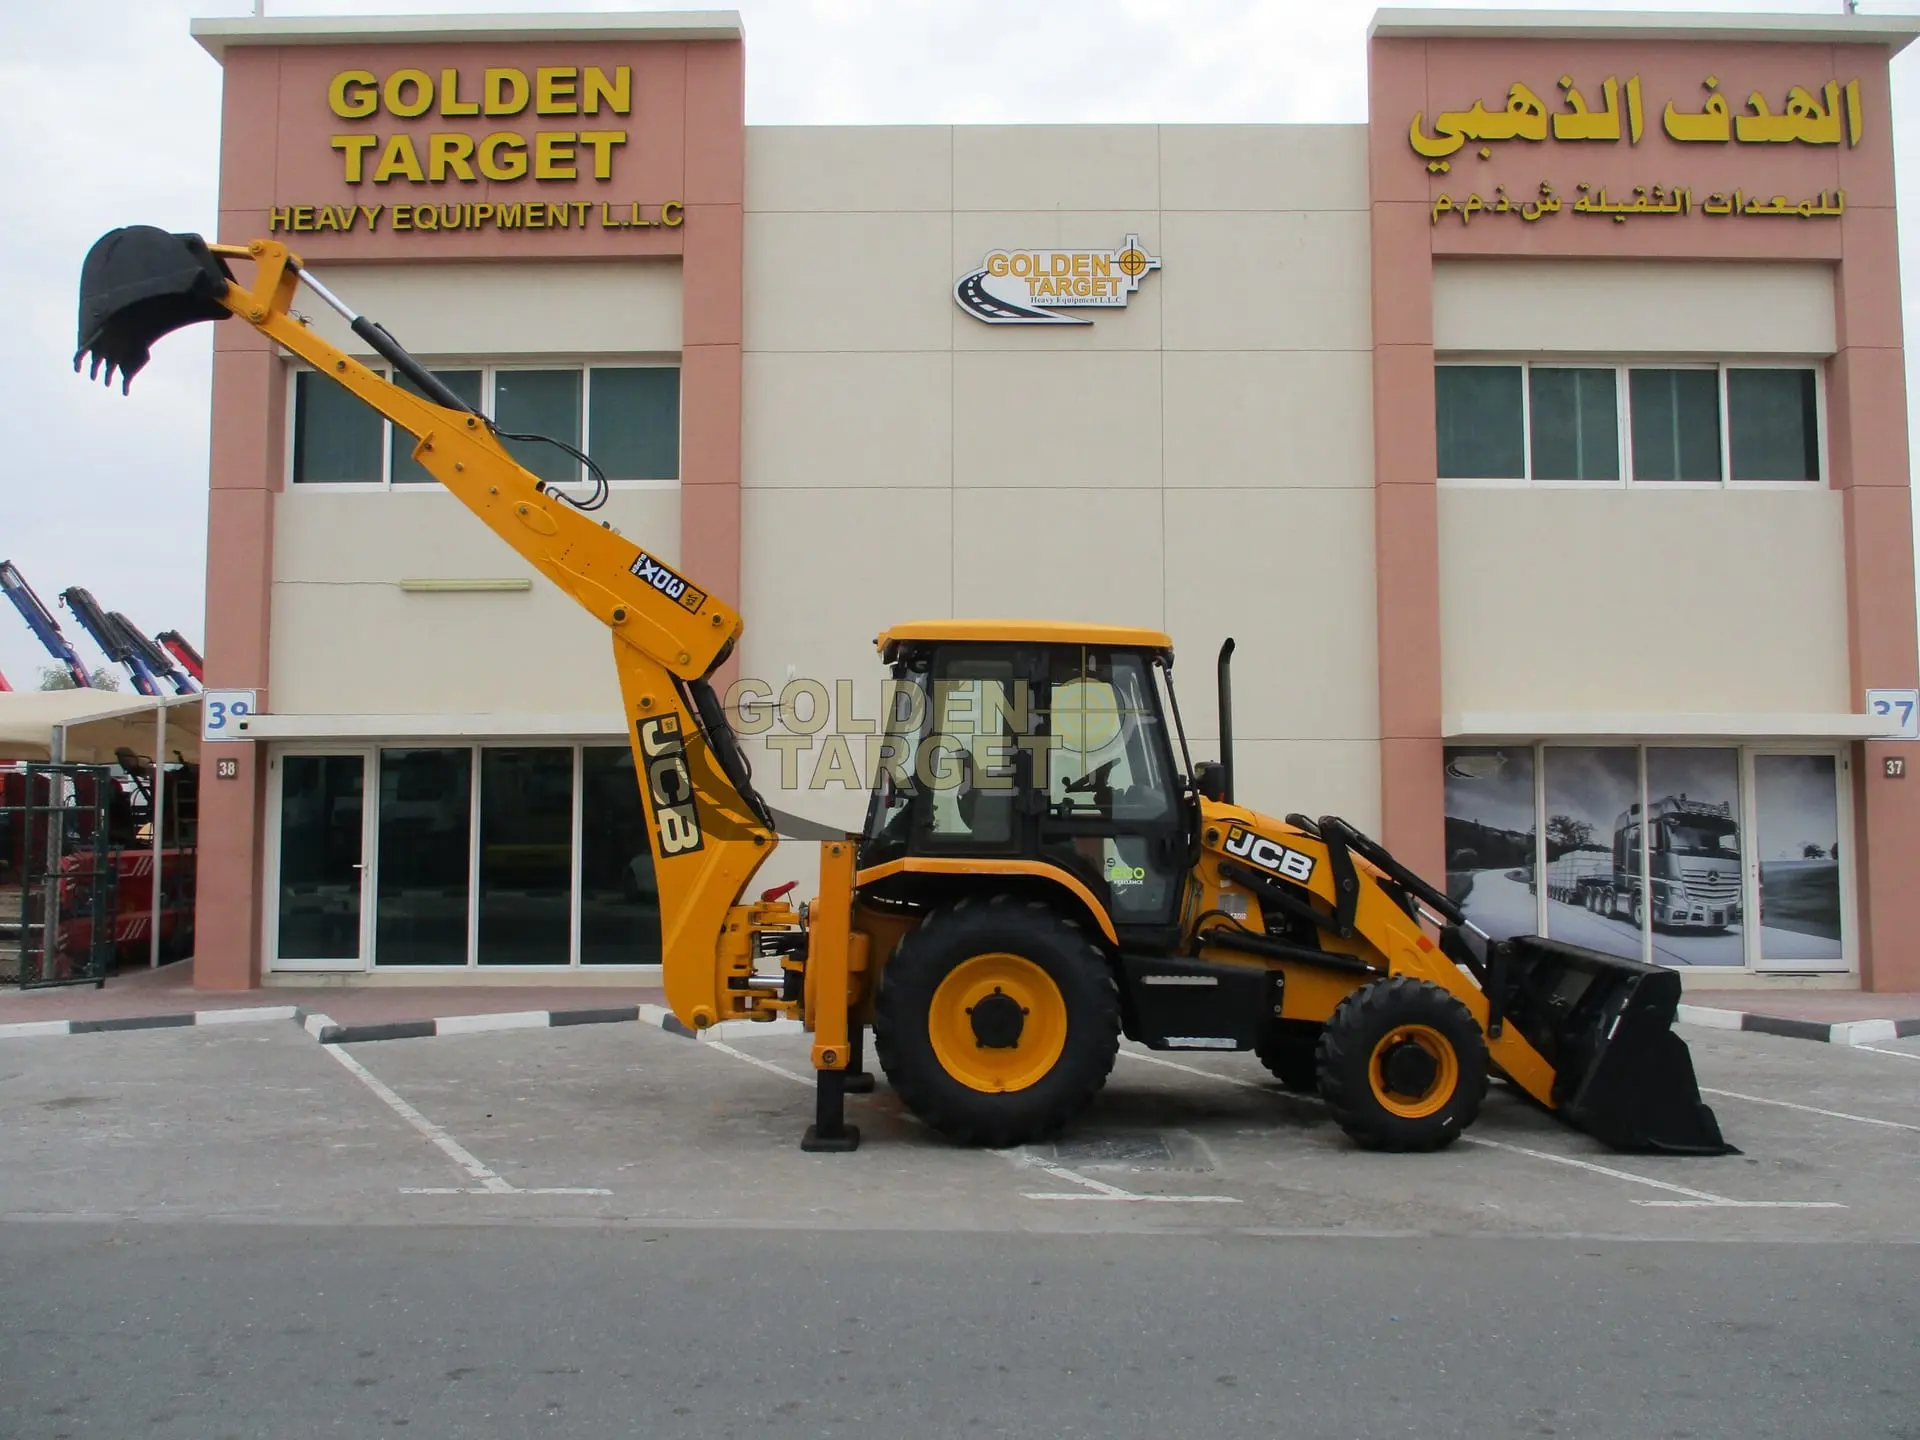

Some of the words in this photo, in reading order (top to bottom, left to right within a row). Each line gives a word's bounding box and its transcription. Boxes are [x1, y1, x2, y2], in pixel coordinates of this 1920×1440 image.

[328, 65, 633, 118] GOLDEN
[1663, 74, 1863, 148] الهدف
[1408, 74, 1645, 173] الذهبي
[331, 130, 626, 184] TARGET
[269, 203, 384, 233] HEAVY
[391, 201, 593, 231] EQUIPMENT
[601, 200, 684, 229] L.L.C
[1570, 181, 1693, 225] الثقيلة
[1702, 187, 1848, 219] للمعدات
[986, 253, 1111, 277] GOLDEN
[1024, 277, 1123, 297] TARGET
[1030, 296, 1054, 304] Heavy
[1056, 296, 1098, 304] Equipment
[638, 559, 685, 599] 3DX
[218, 761, 236, 777] 38
[642, 719, 699, 854] JCB
[1886, 760, 1903, 775] 37
[1226, 832, 1313, 882] JCB
